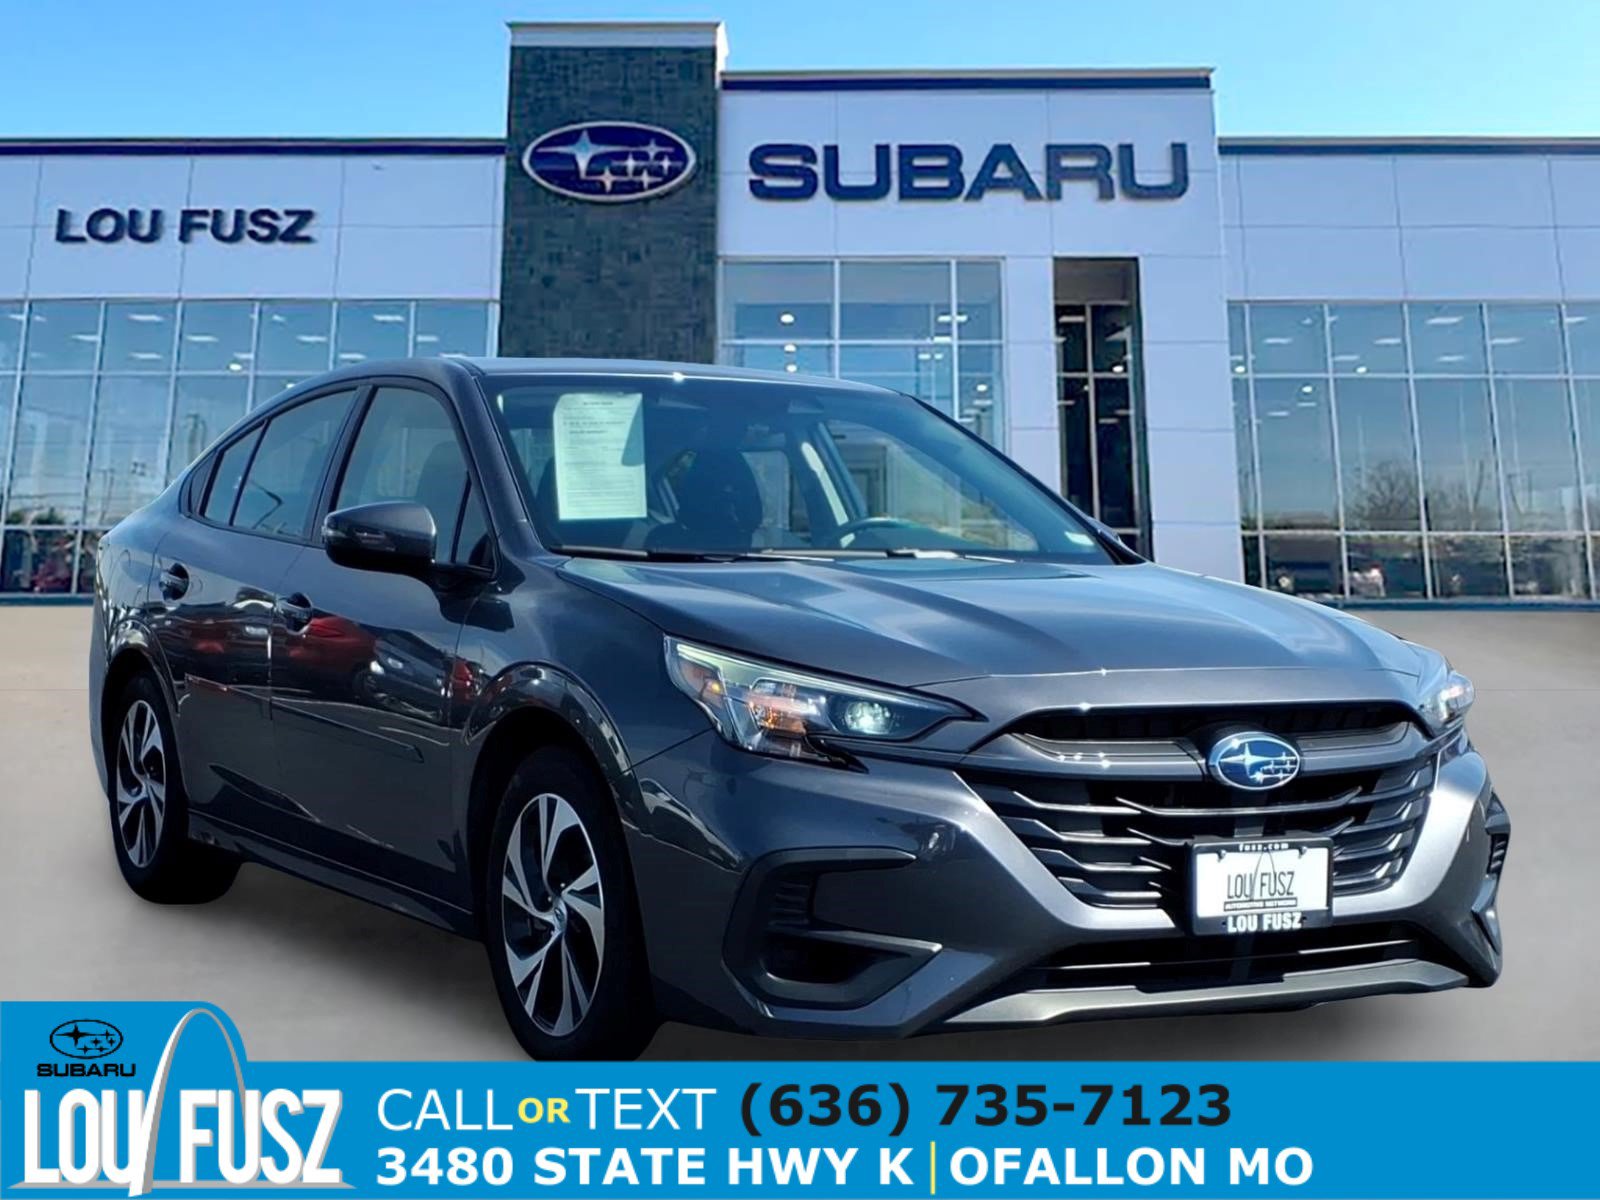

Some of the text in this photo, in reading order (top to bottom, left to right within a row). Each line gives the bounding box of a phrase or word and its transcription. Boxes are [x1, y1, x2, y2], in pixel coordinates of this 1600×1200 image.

[749, 143, 1189, 200] SUBARU
[55, 208, 316, 243] LOU FUSZ
[1227, 871, 1295, 899] LOU FUSZ
[1227, 911, 1302, 933] LOU FUSZ
